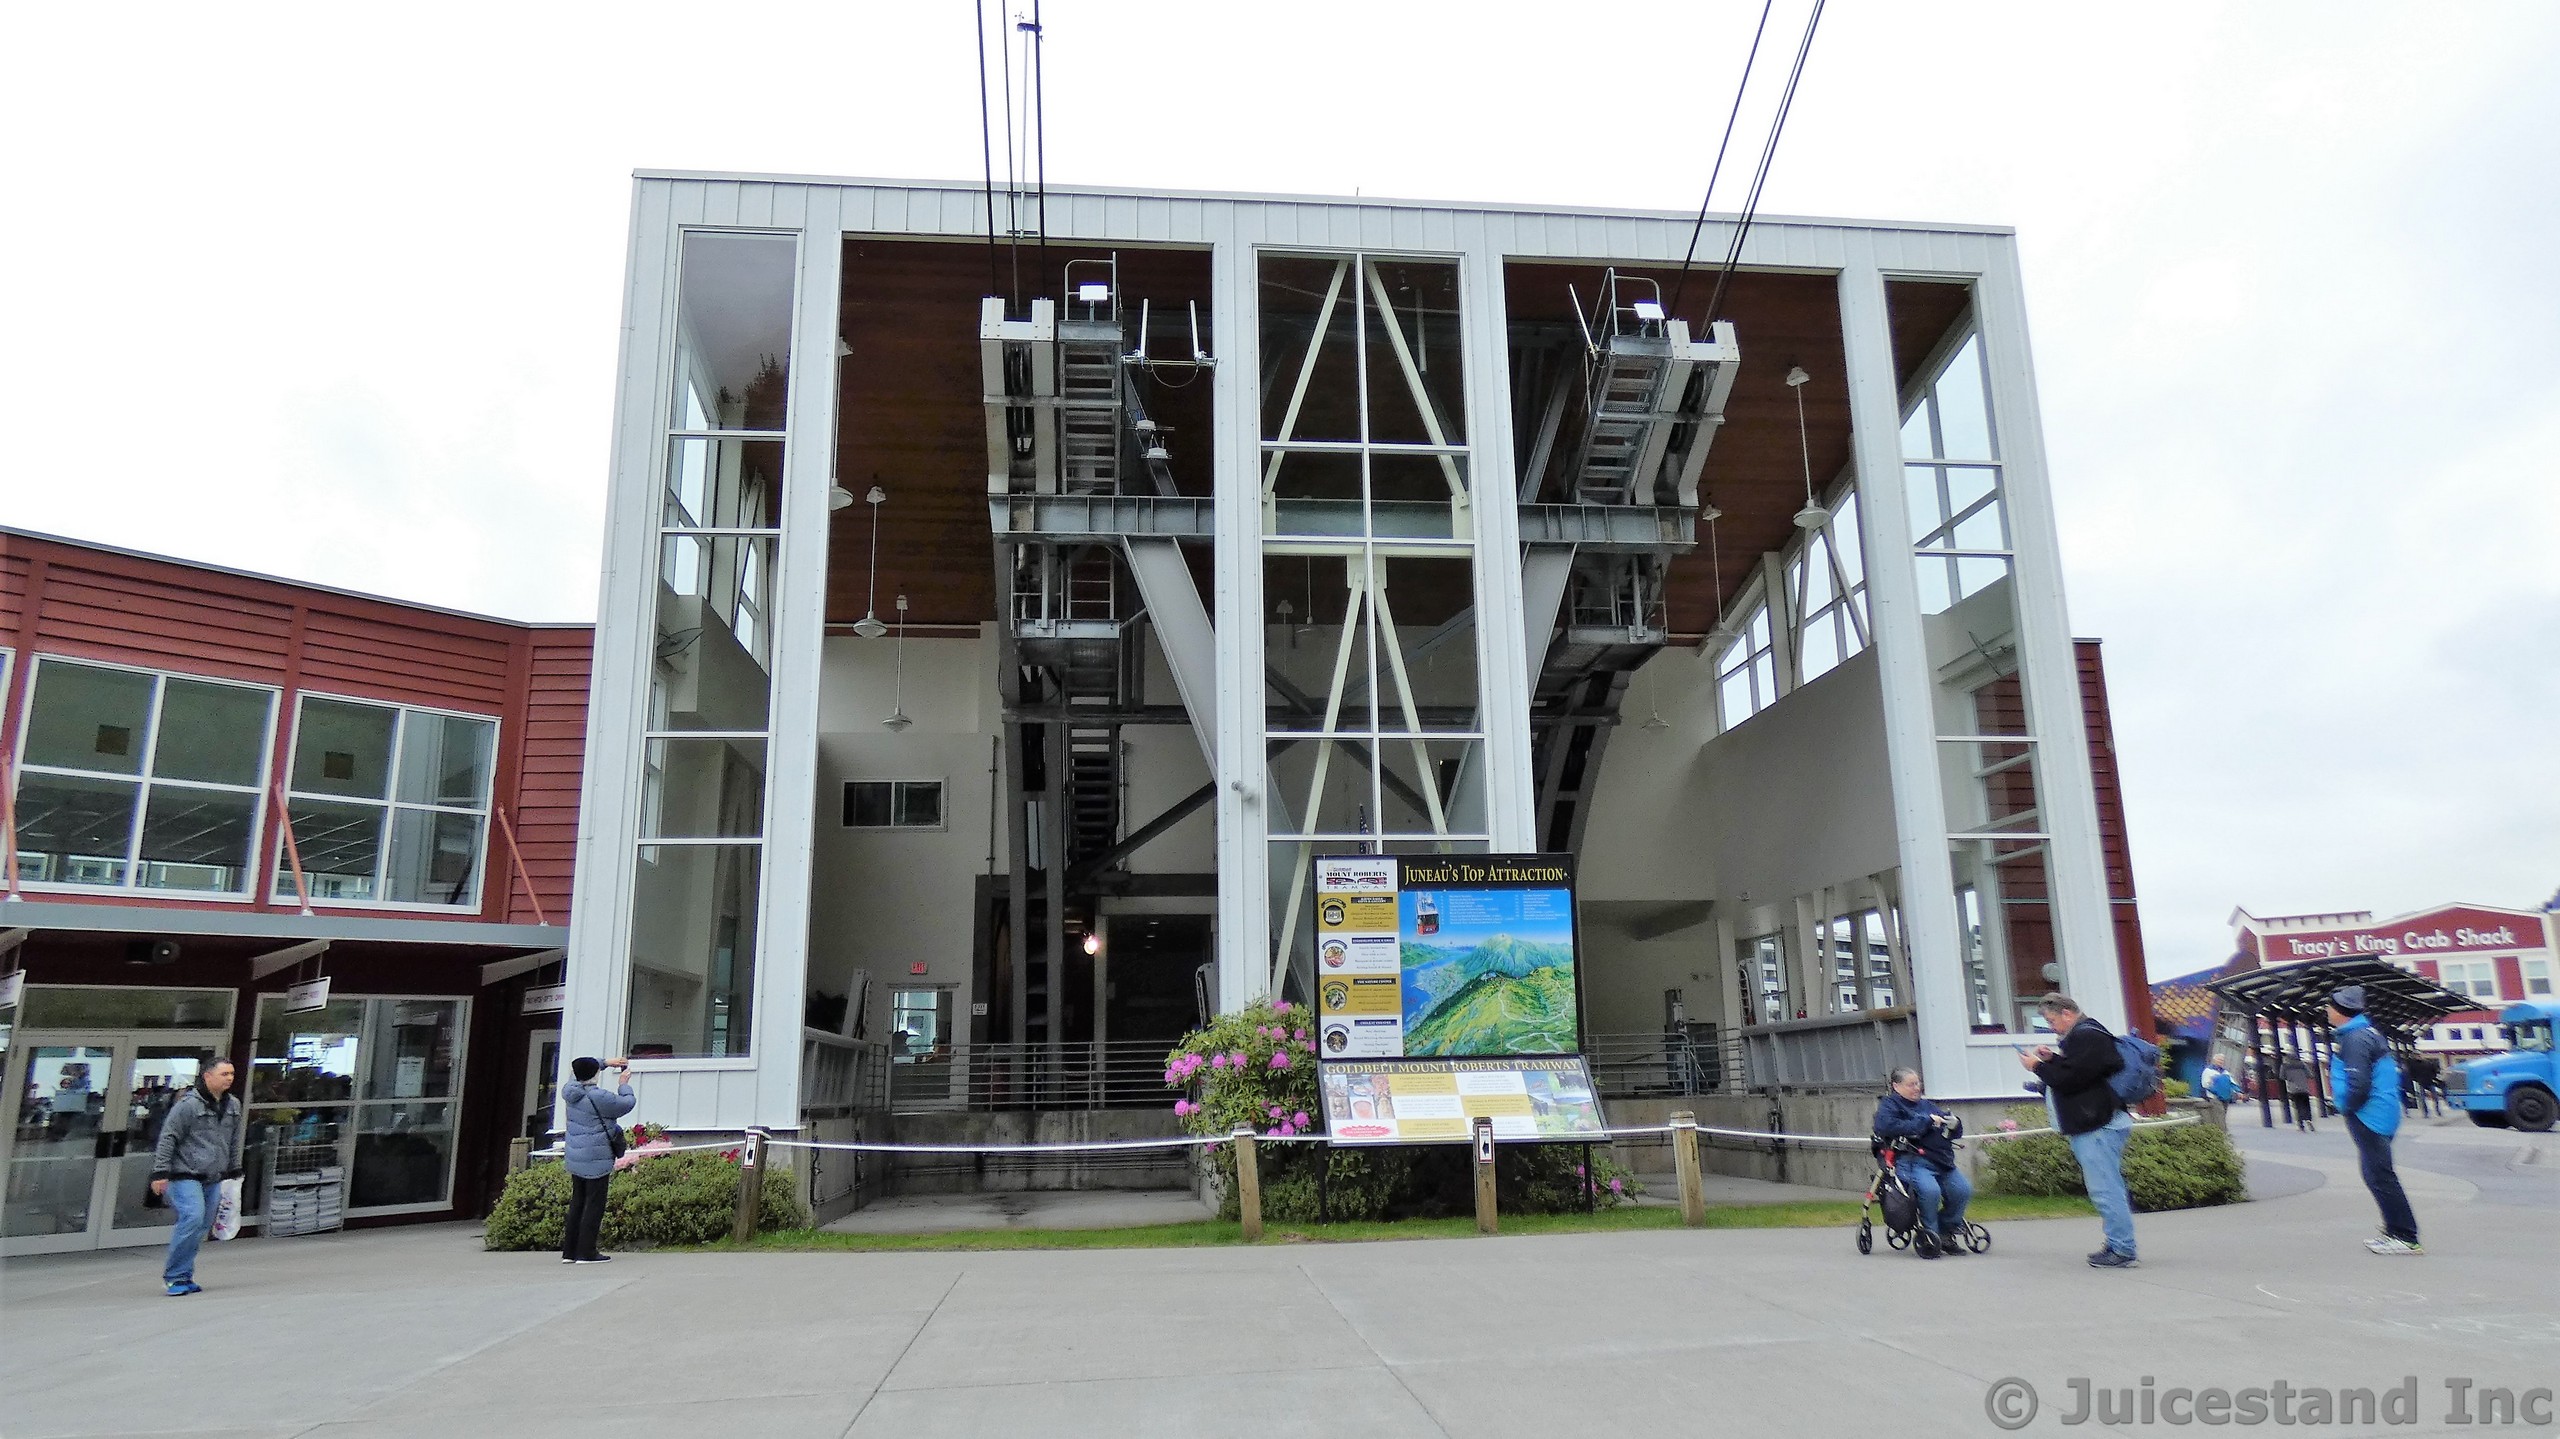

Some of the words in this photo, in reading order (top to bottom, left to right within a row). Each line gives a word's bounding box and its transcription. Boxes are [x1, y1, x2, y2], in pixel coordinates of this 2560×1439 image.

[1405, 864, 1459, 885] JUNEAU'S
[1461, 864, 1485, 882] TOP
[1488, 864, 1564, 882] ATTRACTION
[2288, 935, 2350, 957] Tracy's
[2354, 934, 2399, 955] King
[2403, 928, 2451, 949] Crab
[2455, 925, 2516, 946] Shack
[1326, 1062, 1396, 1074] GOLDBELT
[1398, 1062, 1449, 1073] MOUNT
[1451, 1060, 1510, 1072] ROBERTS
[1511, 1059, 1578, 1071] TRAMWAY
